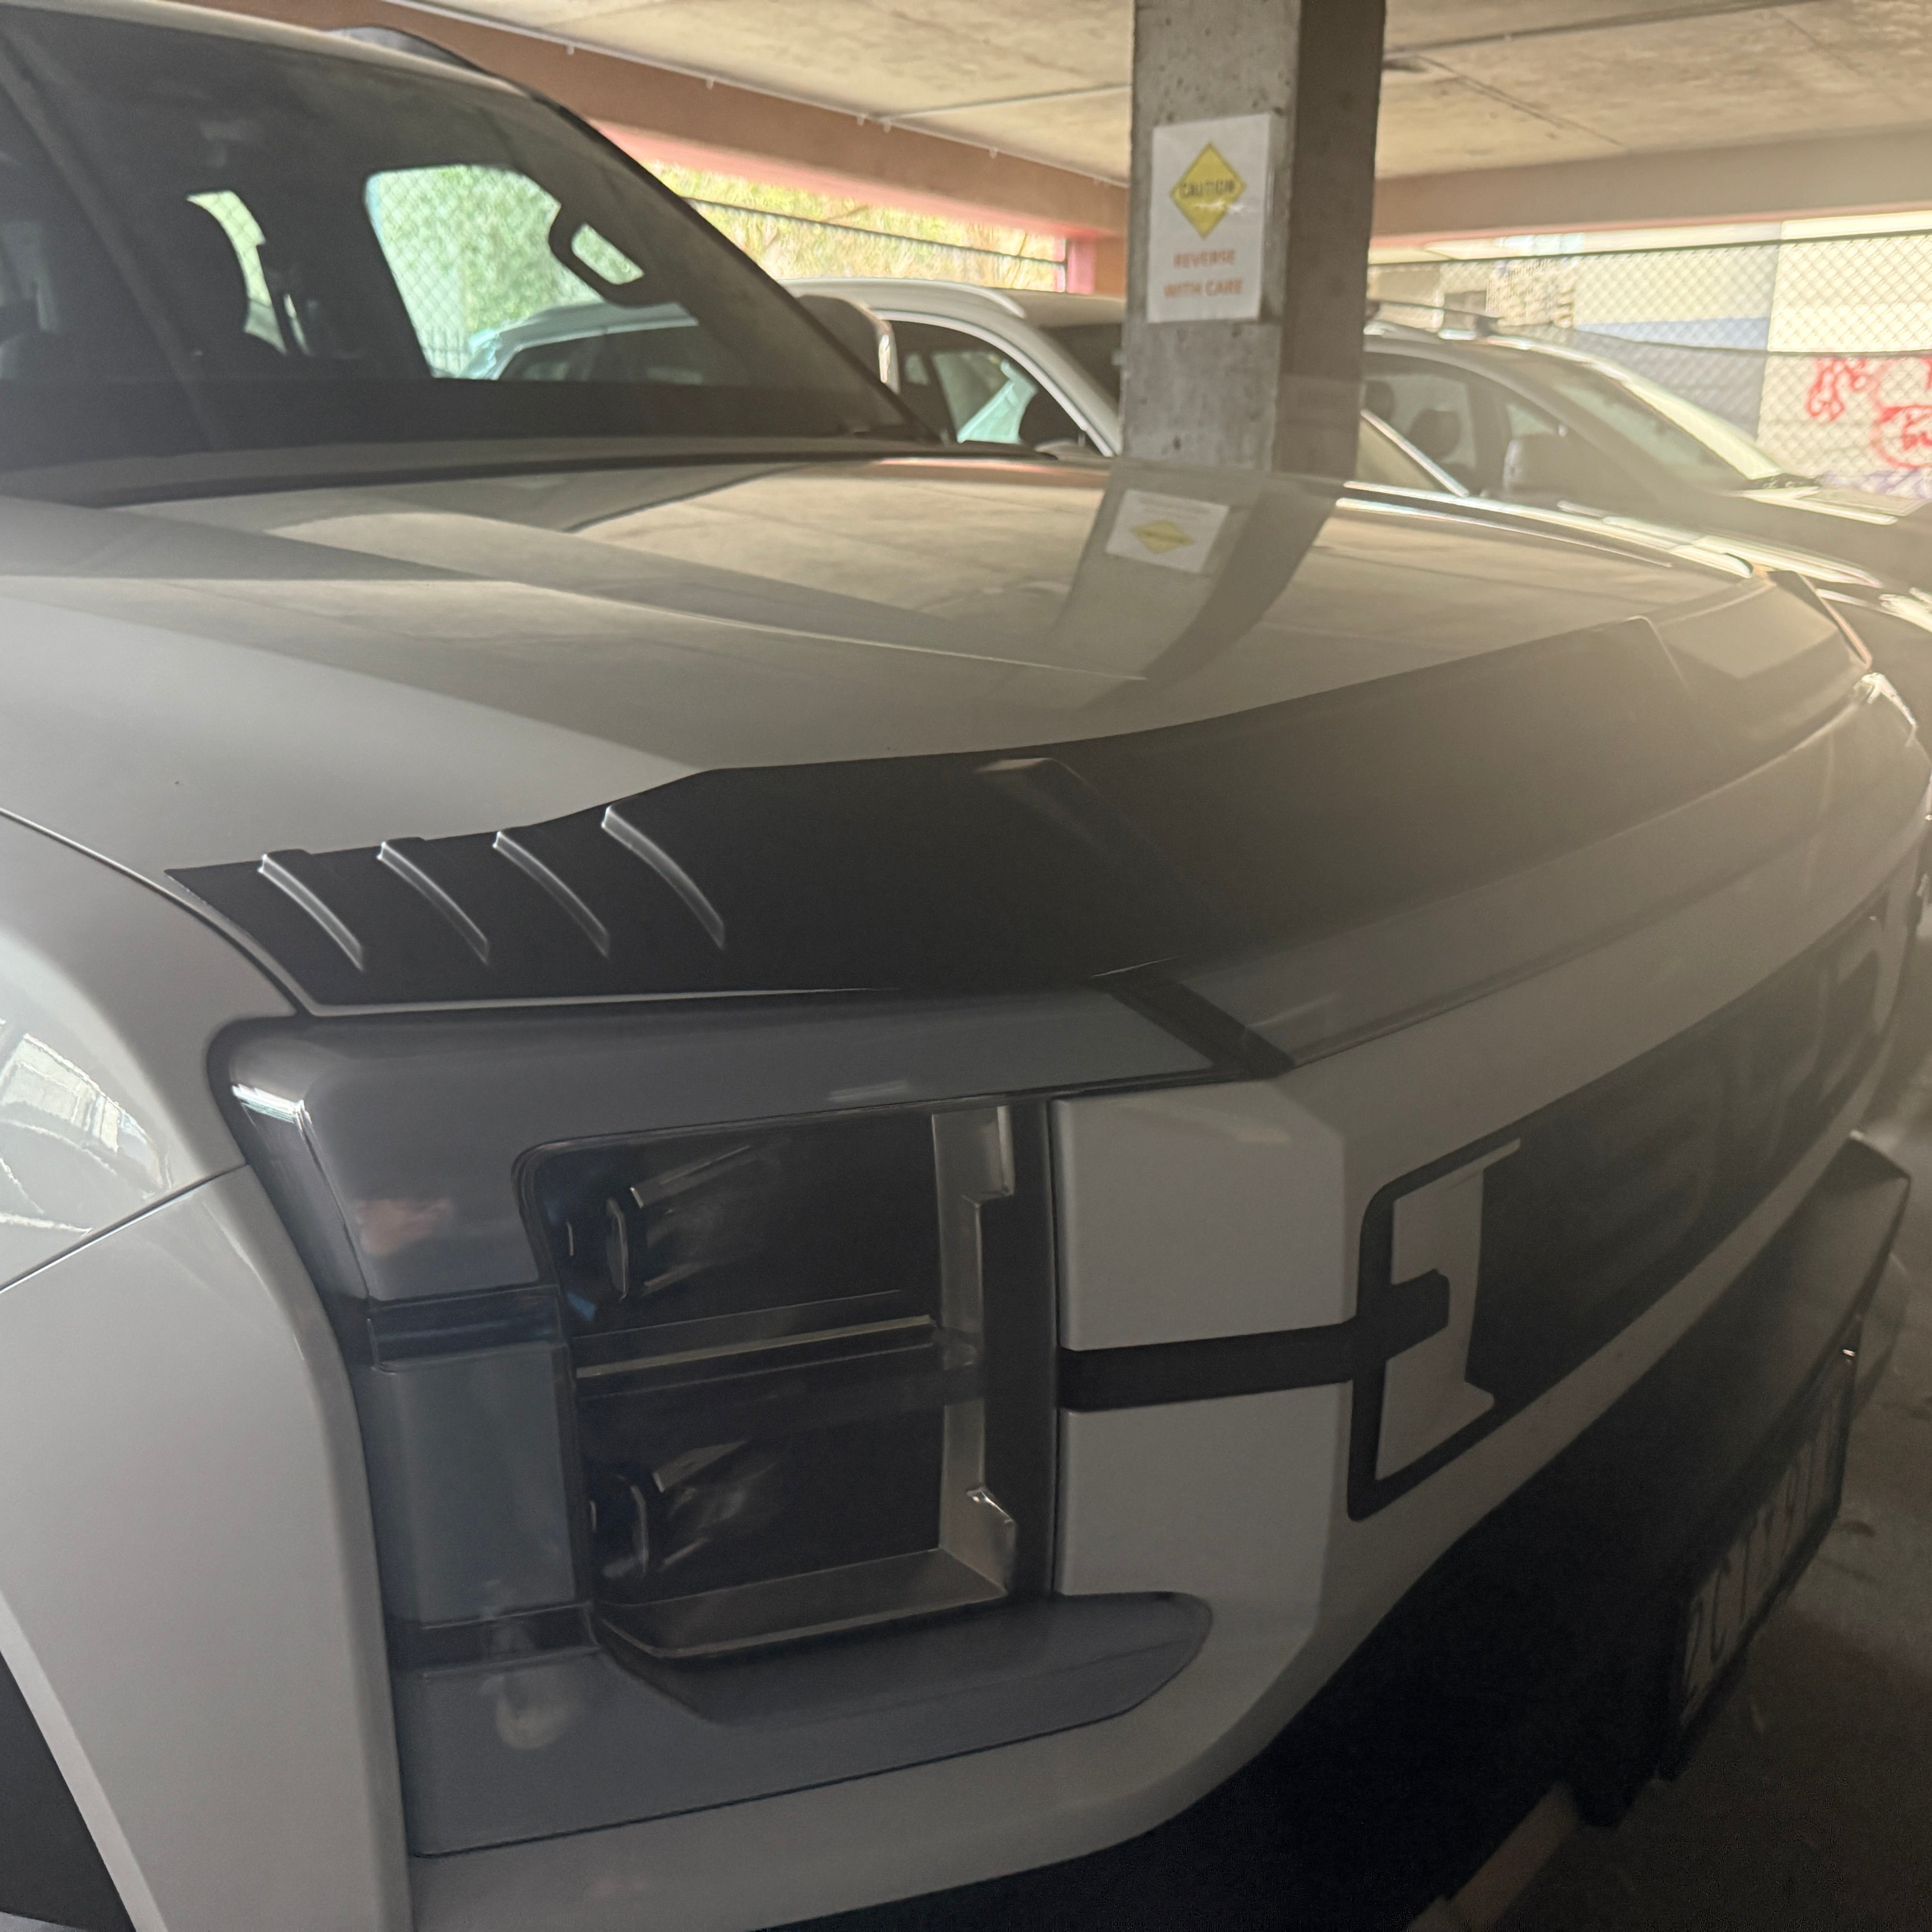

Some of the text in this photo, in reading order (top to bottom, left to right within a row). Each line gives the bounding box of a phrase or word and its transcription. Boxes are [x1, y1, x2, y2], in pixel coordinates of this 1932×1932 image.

[1174, 249, 1235, 267] REVERSE
[1164, 278, 1242, 298] WITH CARE
